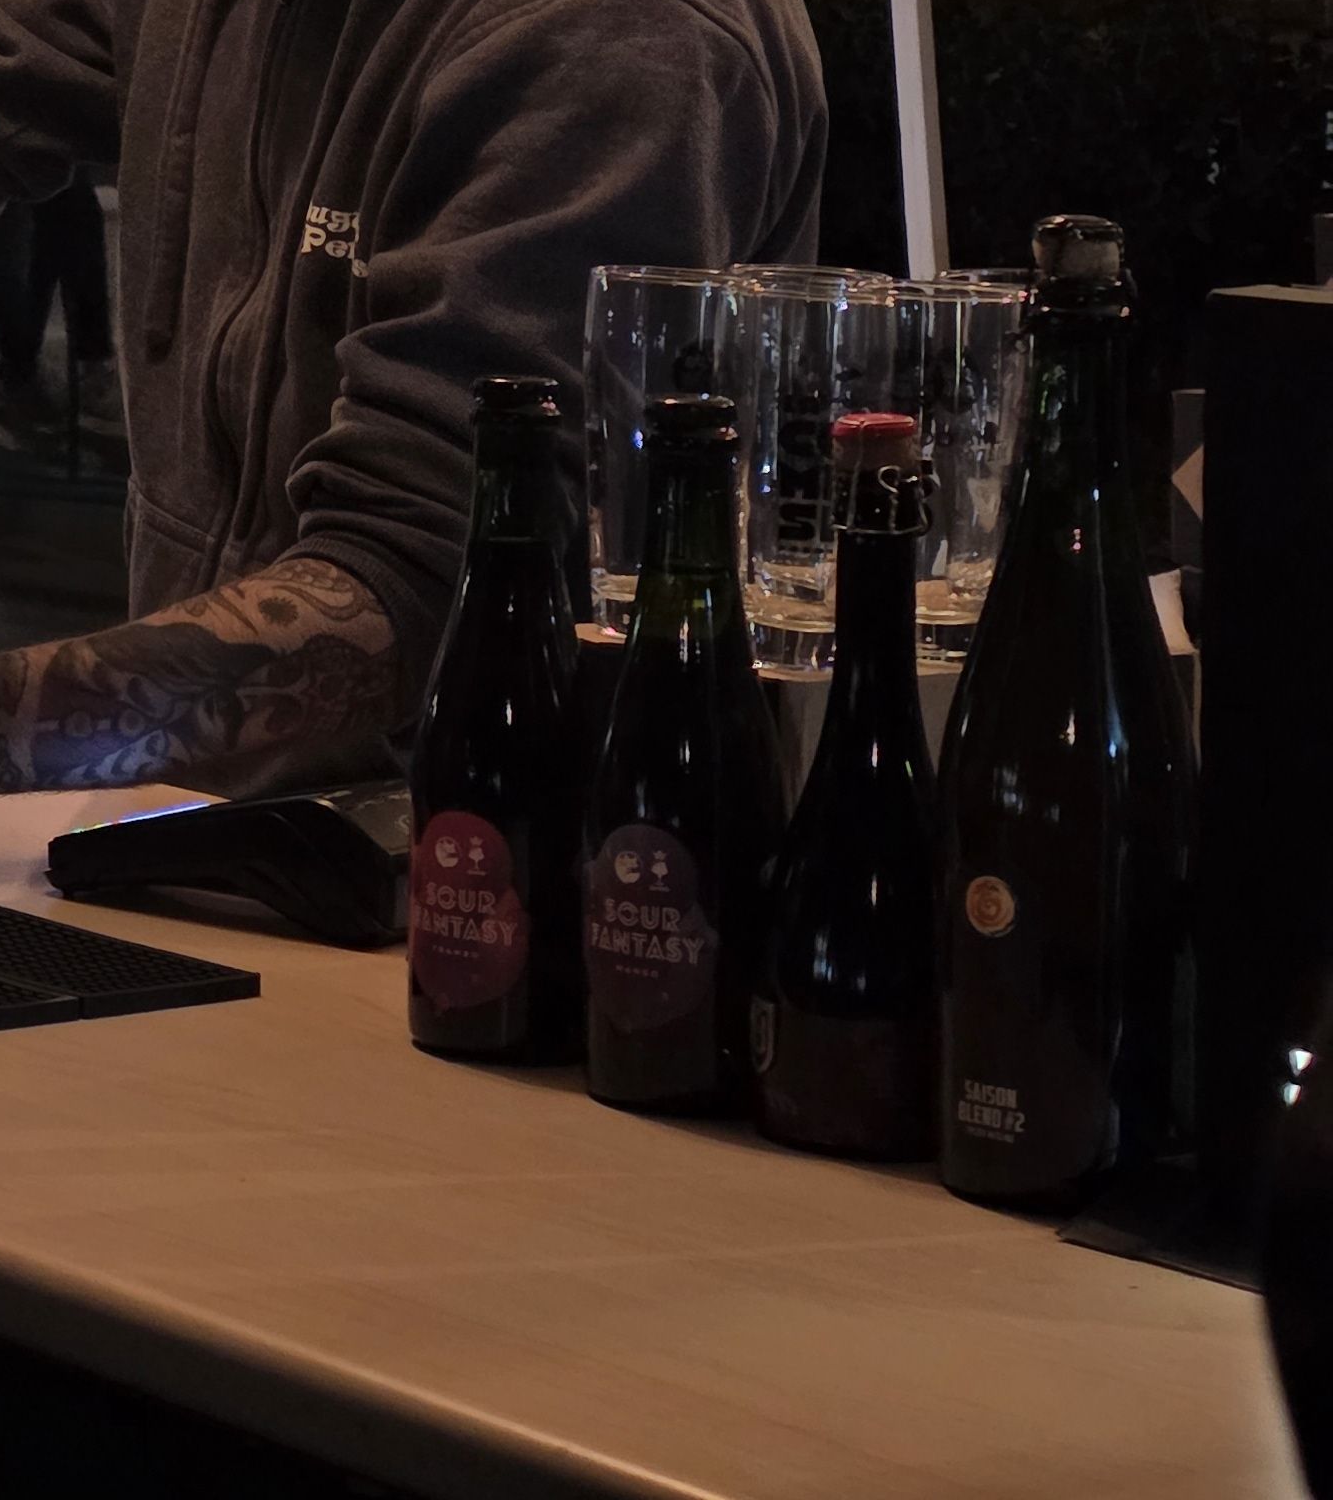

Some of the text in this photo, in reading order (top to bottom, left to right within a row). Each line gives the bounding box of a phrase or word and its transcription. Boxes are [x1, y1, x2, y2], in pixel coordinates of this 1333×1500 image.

[425, 880, 497, 916] SOUR
[604, 897, 681, 933] SOUR
[590, 921, 706, 966] FANTASY
[963, 1078, 1018, 1109] SAISON
[958, 1099, 1002, 1129] BLEND
